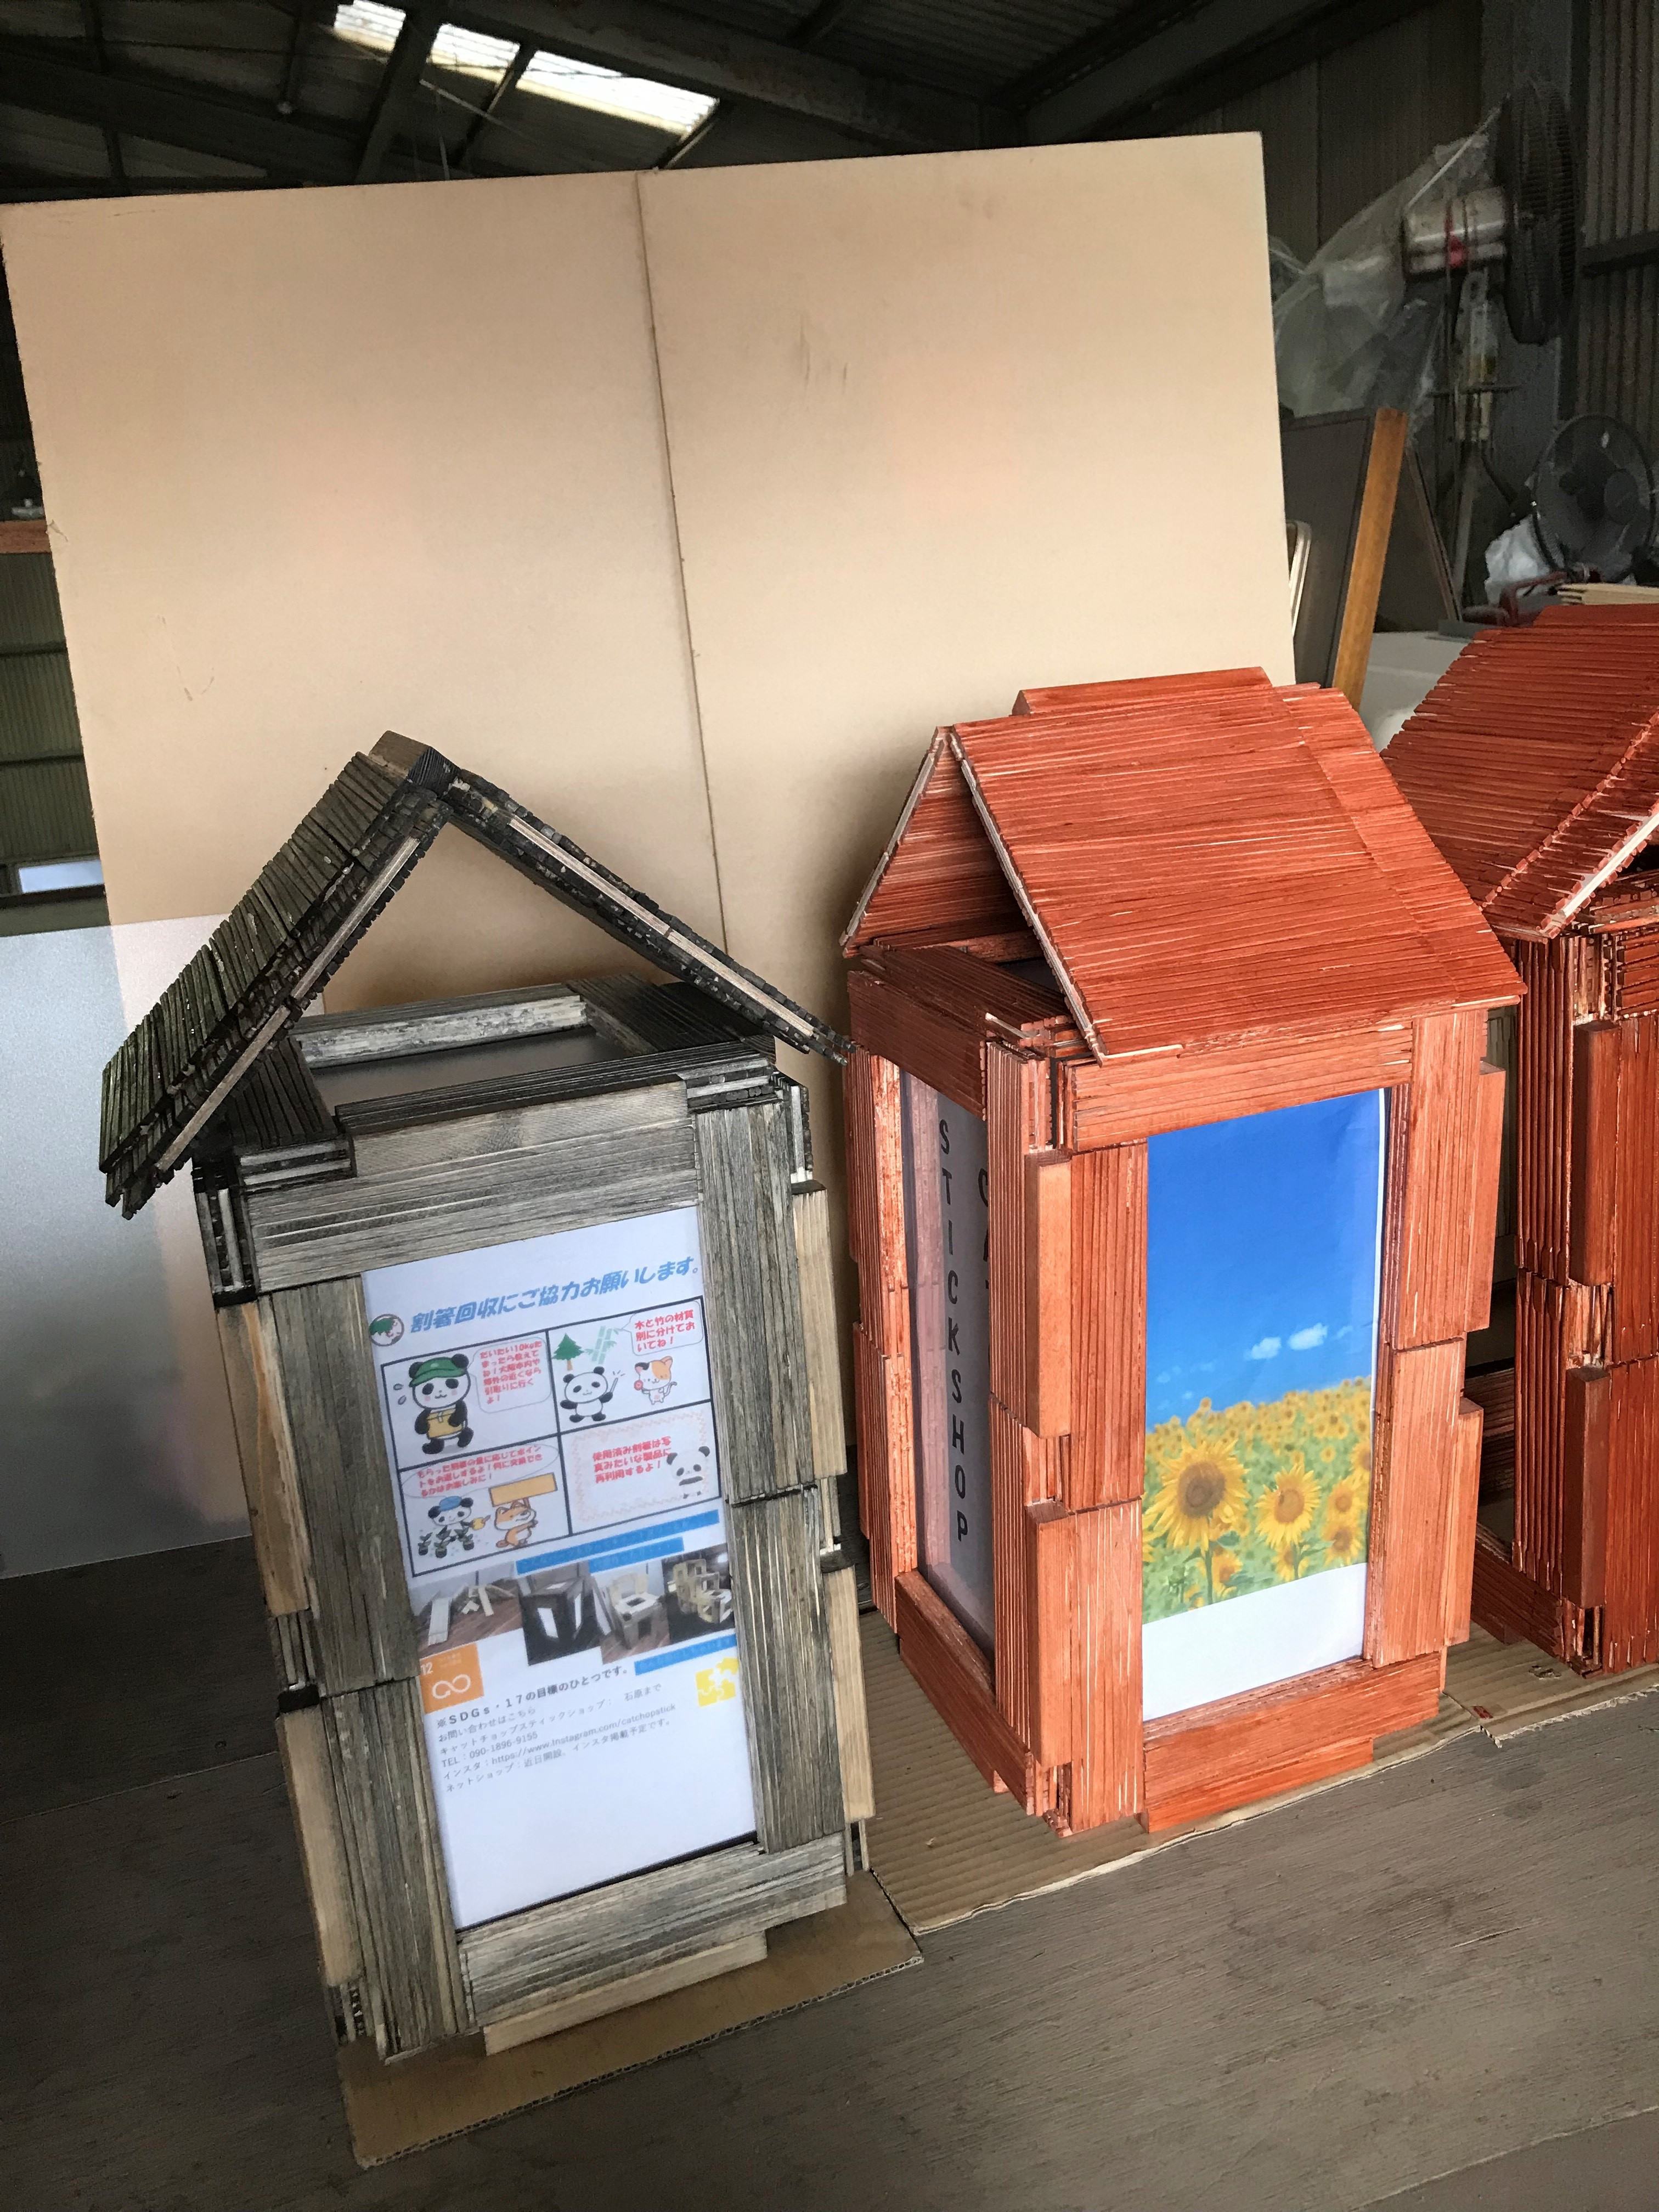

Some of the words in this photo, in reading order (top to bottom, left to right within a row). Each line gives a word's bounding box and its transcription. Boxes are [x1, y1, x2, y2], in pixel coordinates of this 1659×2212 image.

[411, 1257, 698, 1331] 割箸回収にご協力お願いします。
[635, 1309, 694, 1330] 木と竹の材質
[636, 1322, 695, 1342] 別に分けてお
[637, 1336, 674, 1352] いてね！
[592, 1436, 671, 1462] 使用済み割箸は写
[594, 1448, 670, 1473] 真みたいな製品に
[595, 1462, 661, 1483] 再利用するよ！
[420, 1662, 433, 1675] 12
[624, 1683, 662, 1701] 石原まで
[439, 1706, 535, 1742] お問い合わせはこちら
